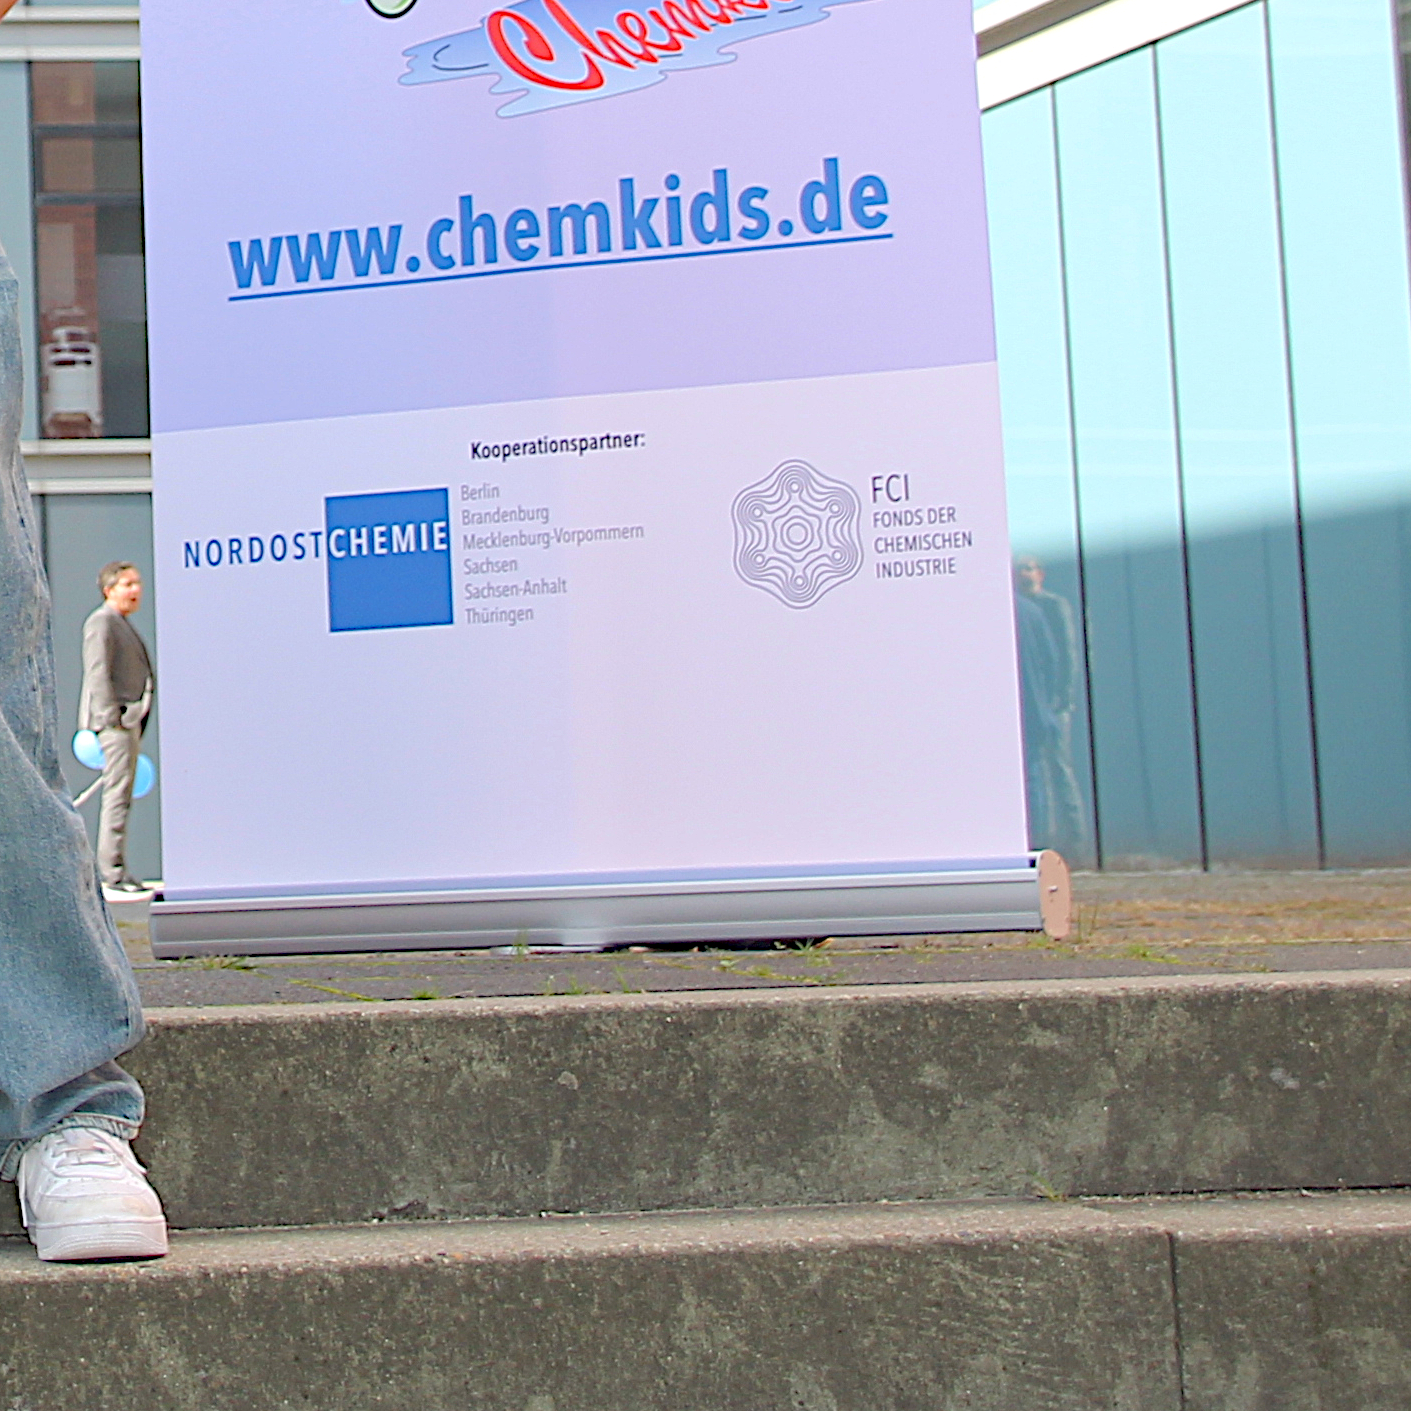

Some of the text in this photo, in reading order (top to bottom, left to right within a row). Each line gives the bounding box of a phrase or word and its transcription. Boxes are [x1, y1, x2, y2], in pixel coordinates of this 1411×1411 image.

[228, 157, 889, 288] www.chemkids.de
[470, 431, 647, 462] Kooperationspartner:
[460, 483, 500, 502] Berlin
[871, 473, 909, 504] FCI
[461, 505, 550, 526] Brandenburg
[873, 506, 957, 529] FONDS DER
[462, 524, 645, 551] Mecklenburg-Vorpommern
[874, 530, 973, 554] CHEMISCHEN
[463, 556, 518, 576] Sachsen
[876, 556, 957, 579] INDUSTRIE
[464, 577, 568, 601] Sachsen-Anhalt
[465, 605, 534, 627] Thüringen
